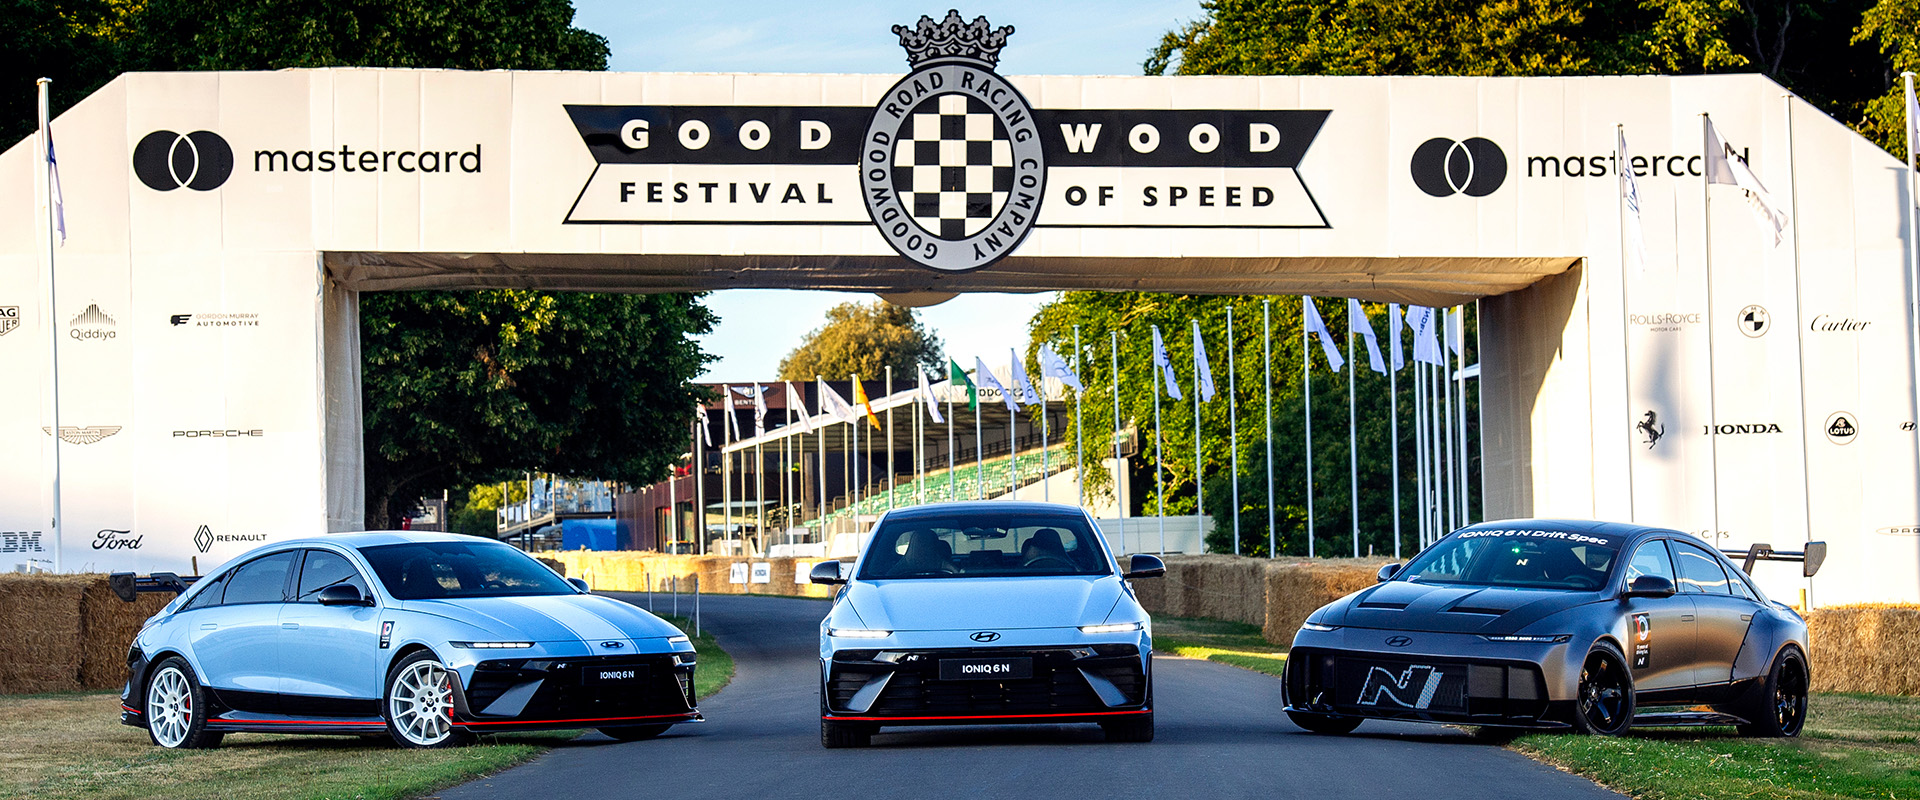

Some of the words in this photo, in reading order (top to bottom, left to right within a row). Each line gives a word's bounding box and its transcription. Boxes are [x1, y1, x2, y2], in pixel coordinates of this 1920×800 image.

[885, 71, 944, 119] ROAD
[961, 71, 1033, 143] RACING
[621, 118, 832, 151] GOOD
[1060, 122, 1281, 154] WOOD
[254, 143, 482, 174] mastercard
[1527, 147, 1750, 178] masterca
[620, 181, 833, 204] FESTIVAL
[869, 131, 938, 260] GOODWOOD
[1064, 185, 1114, 207] OF
[1142, 185, 1275, 207] SPEED
[972, 158, 1038, 261] COMPANY
[1629, 313, 1701, 326] ROLLS-ROYCE
[1810, 314, 1872, 333] Cartier
[70, 328, 117, 342] Qiddiya
[172, 429, 264, 438] PORSCHE
[1703, 423, 1784, 435] HONDA
[1829, 427, 1854, 435] LOTUS
[0, 531, 43, 553] BM
[91, 529, 144, 550] Ford
[216, 533, 268, 543] RENAULT
[1458, 530, 1505, 539] IONIQ
[1531, 530, 1568, 539] Drift
[1567, 533, 1609, 545] Spec
[1516, 558, 1529, 566] N
[600, 671, 622, 680] IONIQ
[622, 670, 629, 679] 6
[628, 670, 635, 679] N
[962, 664, 991, 674] IONIQ
[993, 664, 1001, 673] 6
[1002, 664, 1010, 673] N
